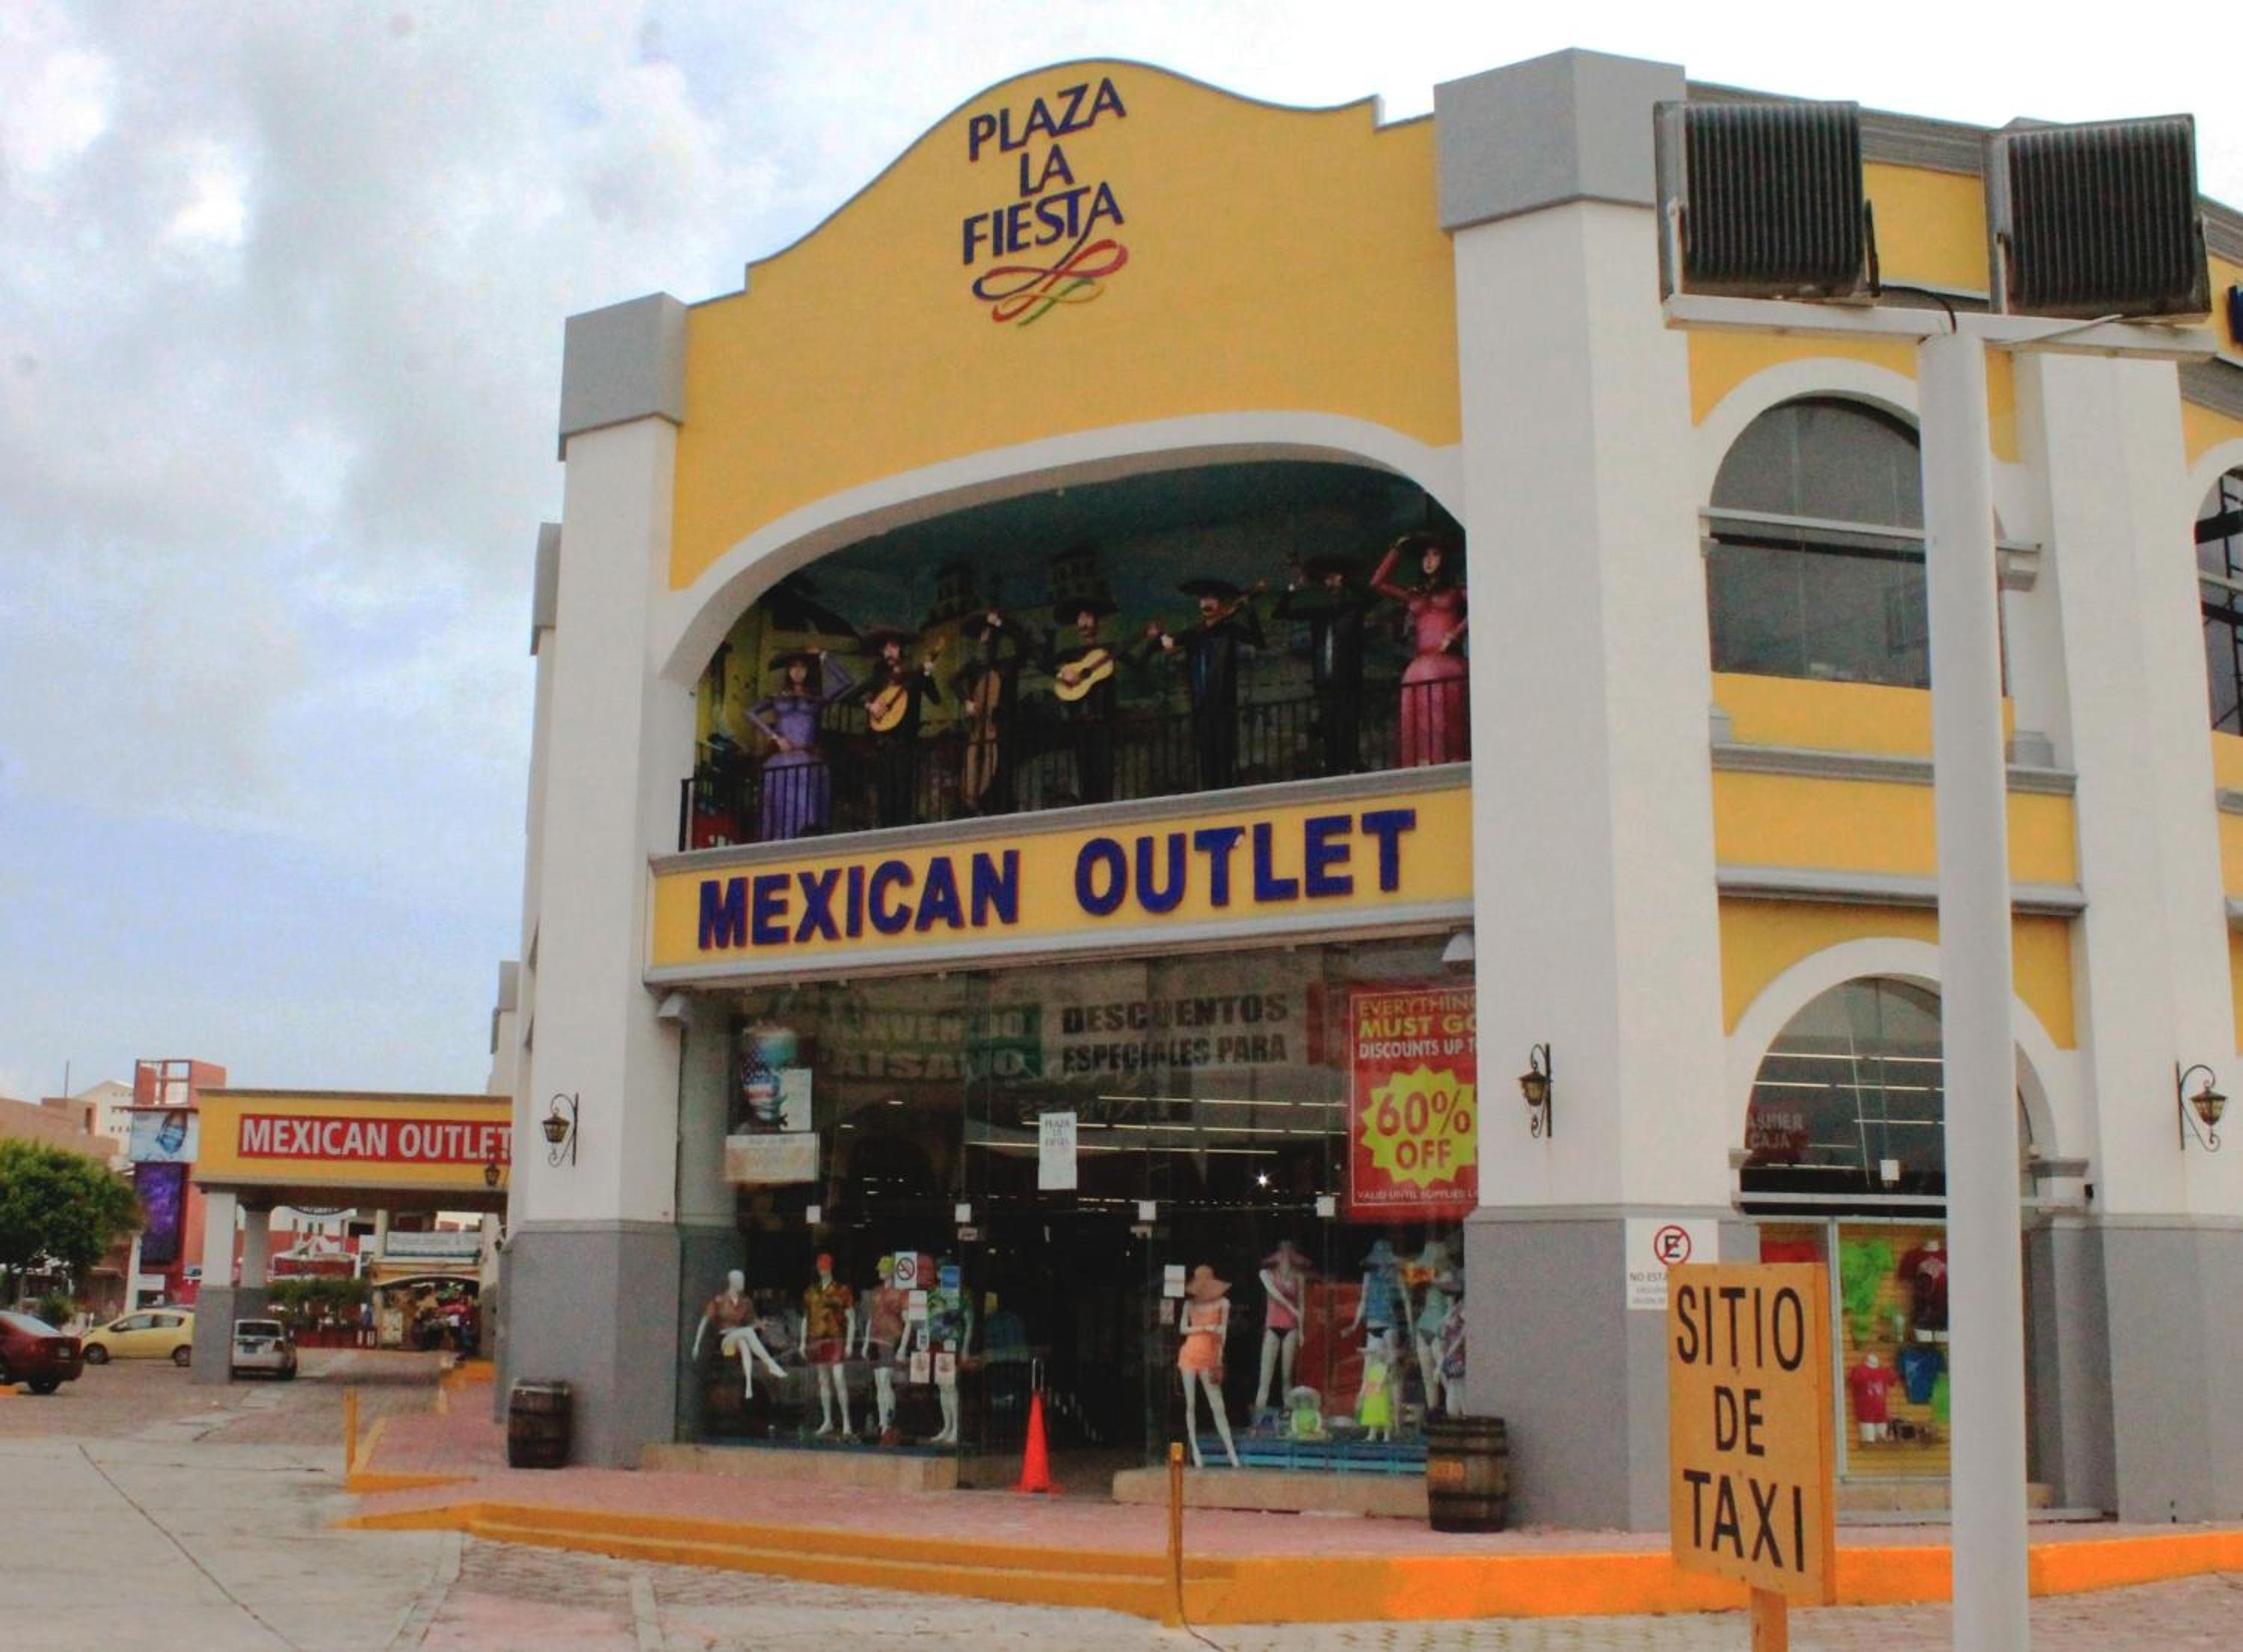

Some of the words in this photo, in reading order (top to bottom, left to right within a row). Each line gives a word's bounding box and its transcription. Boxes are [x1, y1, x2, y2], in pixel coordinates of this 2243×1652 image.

[969, 77, 1126, 161] PLAZA
[1020, 144, 1074, 197] LA
[963, 182, 1124, 265] FIESTA
[698, 849, 1020, 950] MEXICAN
[1074, 809, 1415, 916] OUTLET
[1062, 993, 1288, 1033] DESCUENTOS
[1359, 1016, 1433, 1038] MUST
[1062, 1037, 1210, 1071] ESPECIALES
[1217, 1032, 1287, 1063] PARA
[1359, 1040, 1440, 1059] DISCOUNTS
[1444, 1038, 1462, 1055] UP
[1469, 1038, 1476, 1052] T
[1376, 1088, 1471, 1136] 60%
[241, 1118, 387, 1157] MEXICAN
[399, 1124, 512, 1161] OUTLET
[1395, 1138, 1451, 1169] OFF
[1630, 1272, 1645, 1281] NO
[1676, 1285, 1804, 1371] SITIO
[1713, 1385, 1764, 1456] DE
[1683, 1469, 1804, 1573] TAXI
